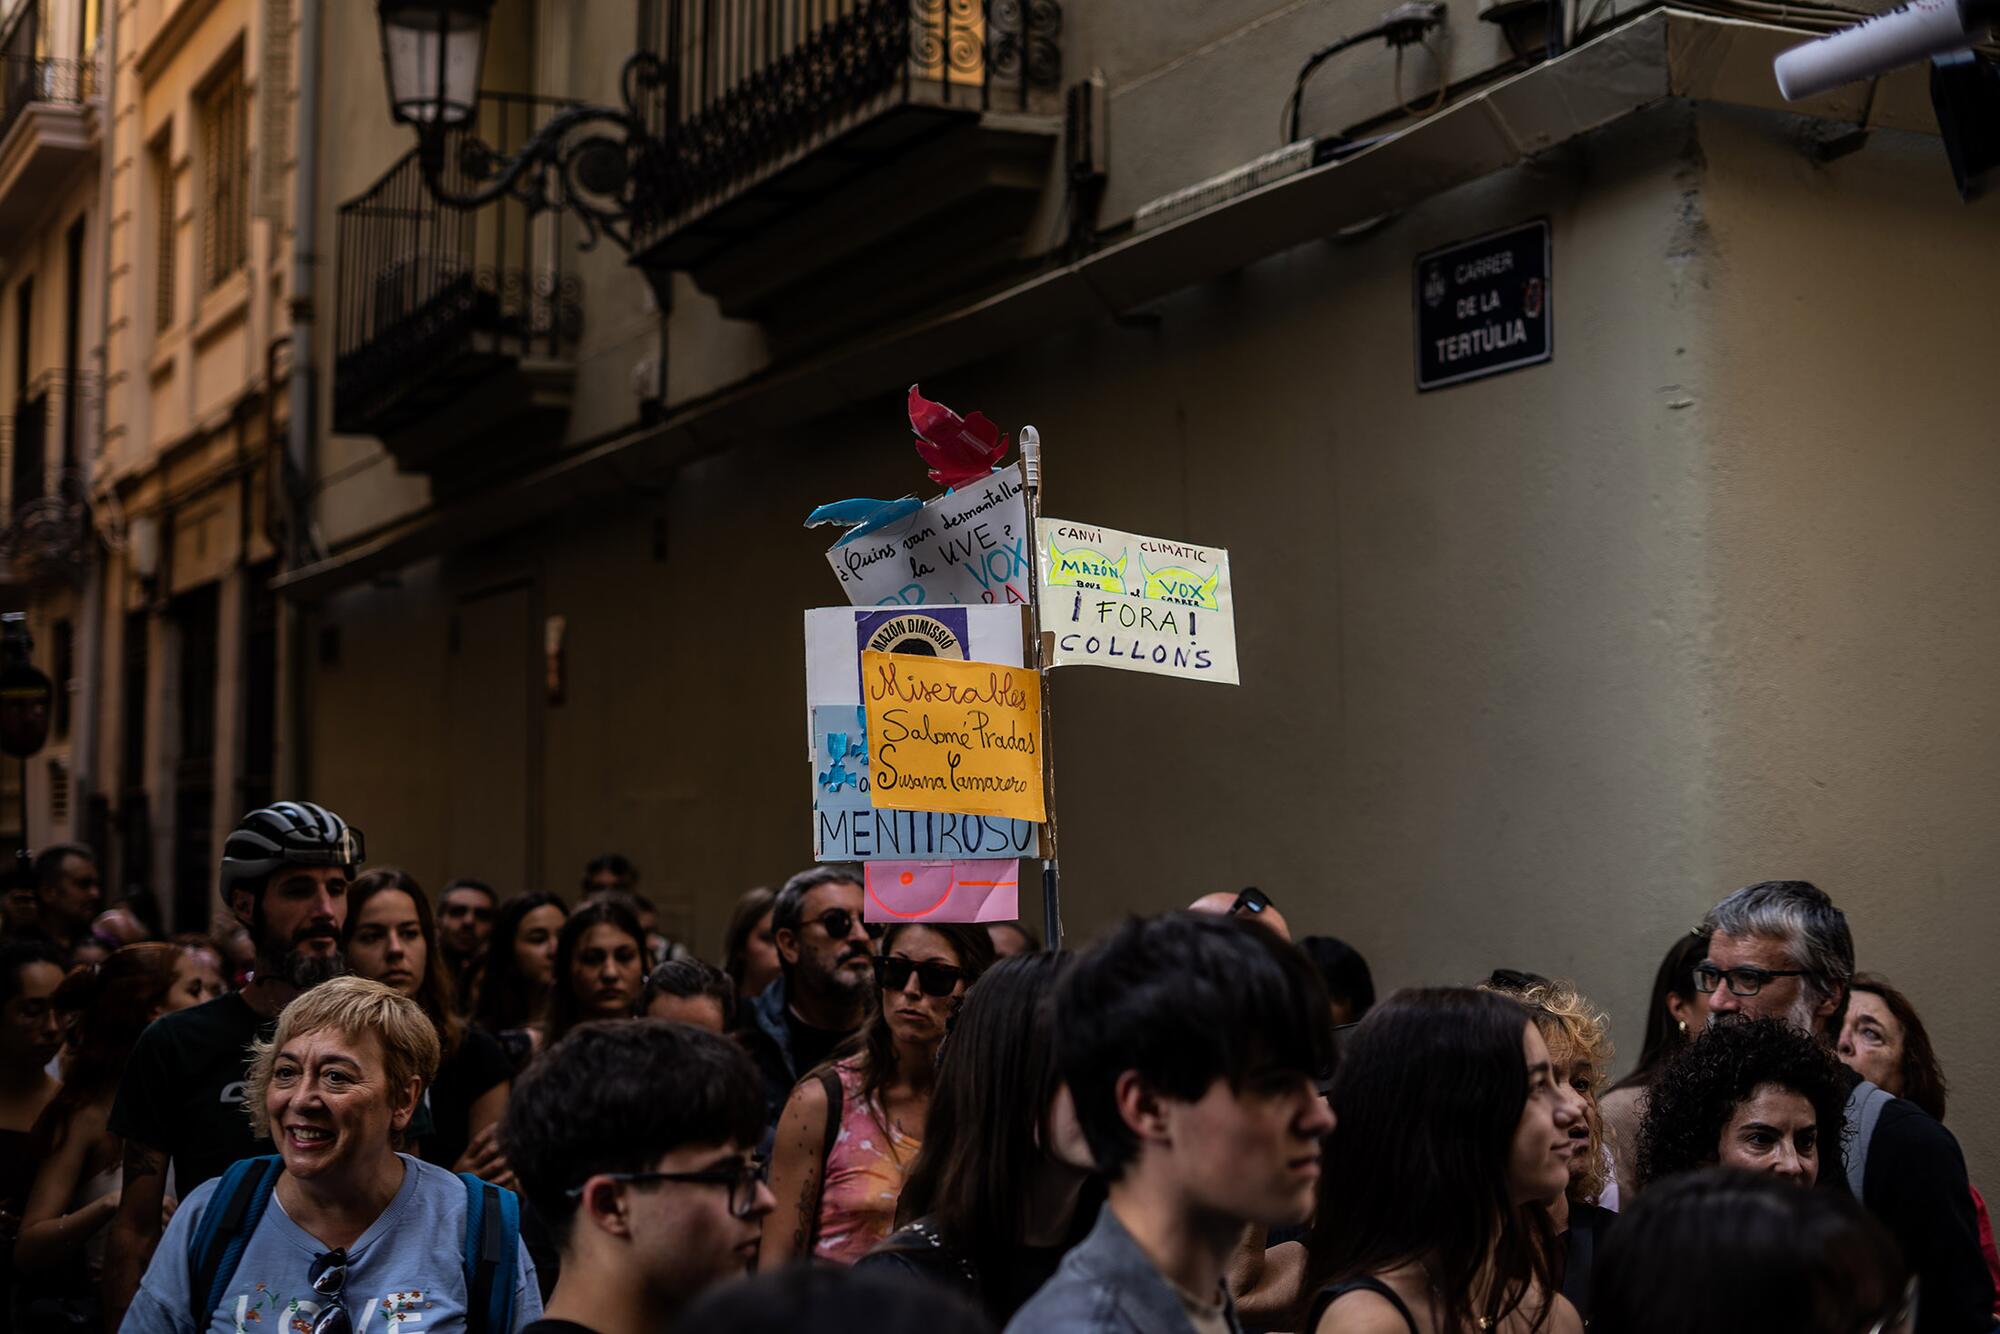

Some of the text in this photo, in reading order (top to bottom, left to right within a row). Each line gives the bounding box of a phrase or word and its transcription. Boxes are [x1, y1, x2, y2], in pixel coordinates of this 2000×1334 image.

[1455, 250, 1515, 285] CARRER
[1457, 289, 1501, 318] DE LA
[1436, 318, 1528, 364] TERTÚLIA
[903, 527, 936, 550] van
[909, 556, 935, 579] la
[964, 537, 1028, 589] VOX
[1060, 559, 1205, 601] MAZÓN VOX
[871, 618, 957, 652] MAZÓN DIMISSIÓ
[1060, 634, 1213, 669] COLLONS
[871, 662, 1027, 711] Miserables
[883, 709, 1036, 755] Salomé Pradas
[876, 744, 947, 791] Susana
[820, 808, 1033, 855] MENTIROSO
